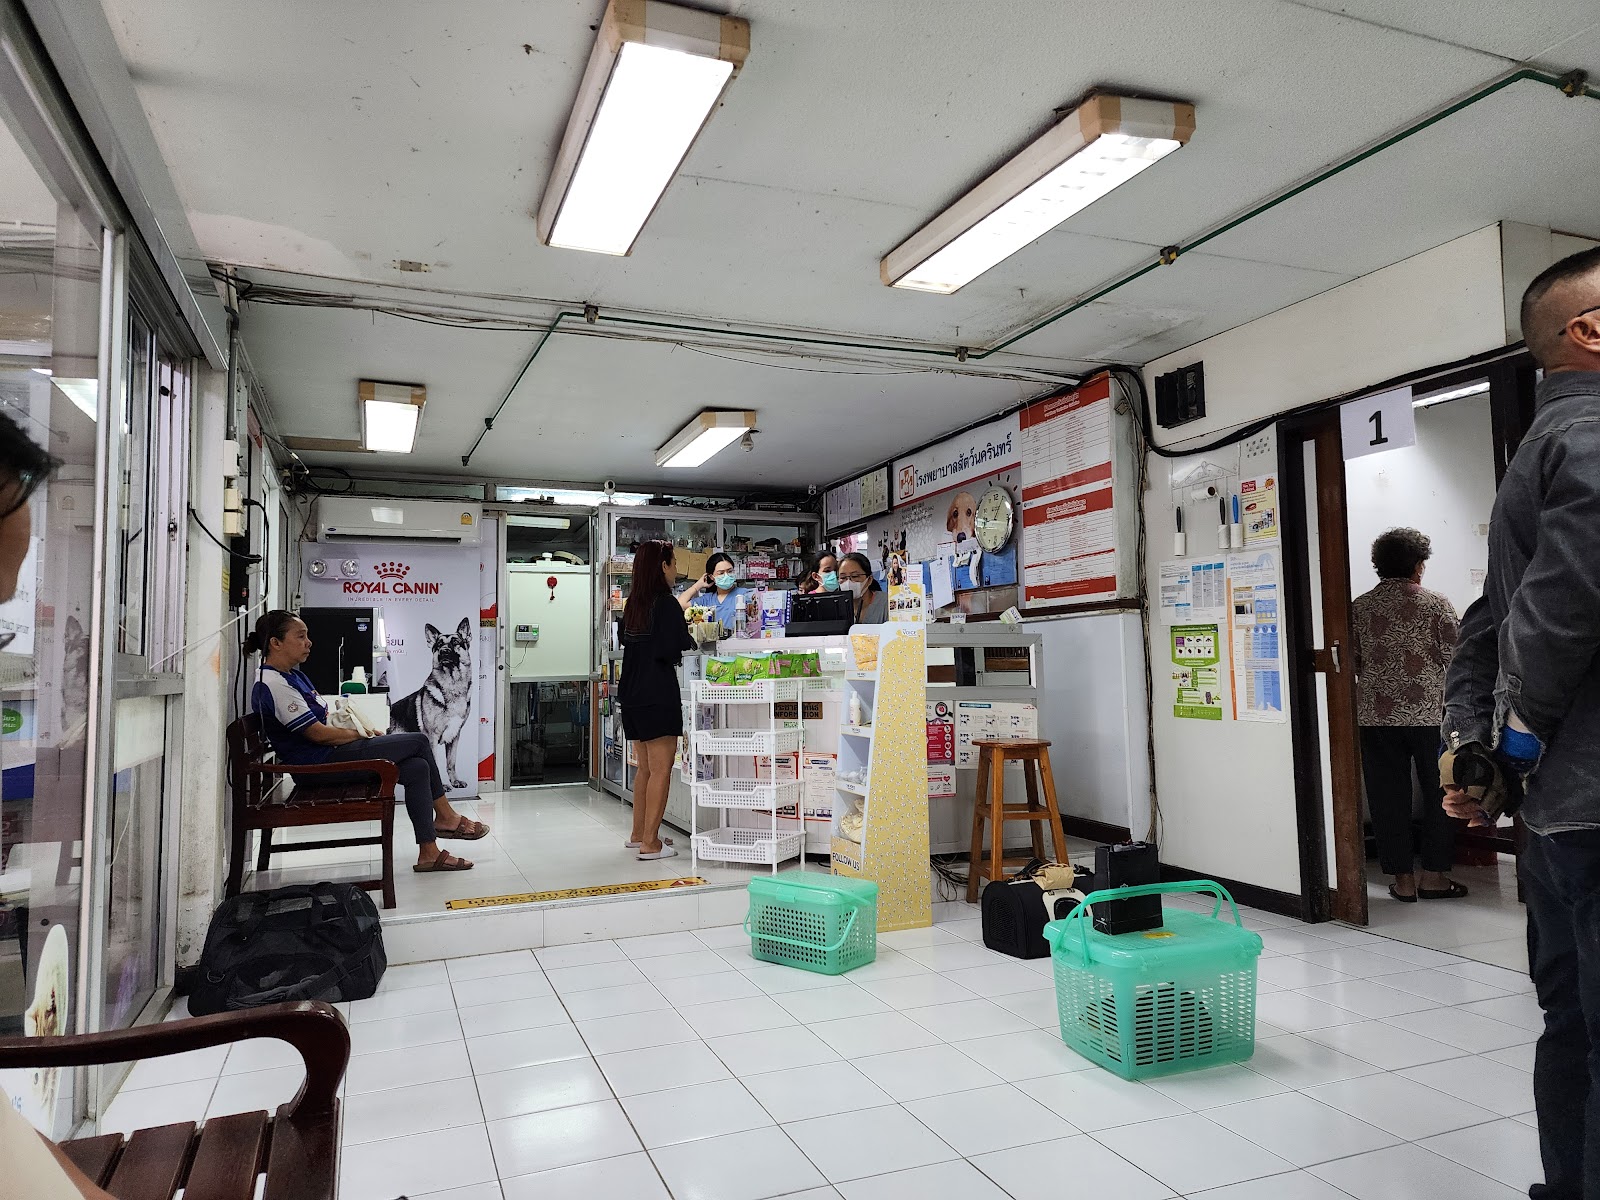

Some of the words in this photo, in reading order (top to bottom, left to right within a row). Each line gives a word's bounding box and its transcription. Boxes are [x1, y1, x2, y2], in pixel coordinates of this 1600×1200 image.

[1368, 410, 1388, 446] 1
[914, 431, 1012, 488] โรงพยาบาลสัตว์นครินทร์
[343, 581, 389, 594] ROYAL
[392, 582, 439, 595] CANIN
[832, 852, 852, 867] FOLLOW
[852, 860, 860, 871] US
